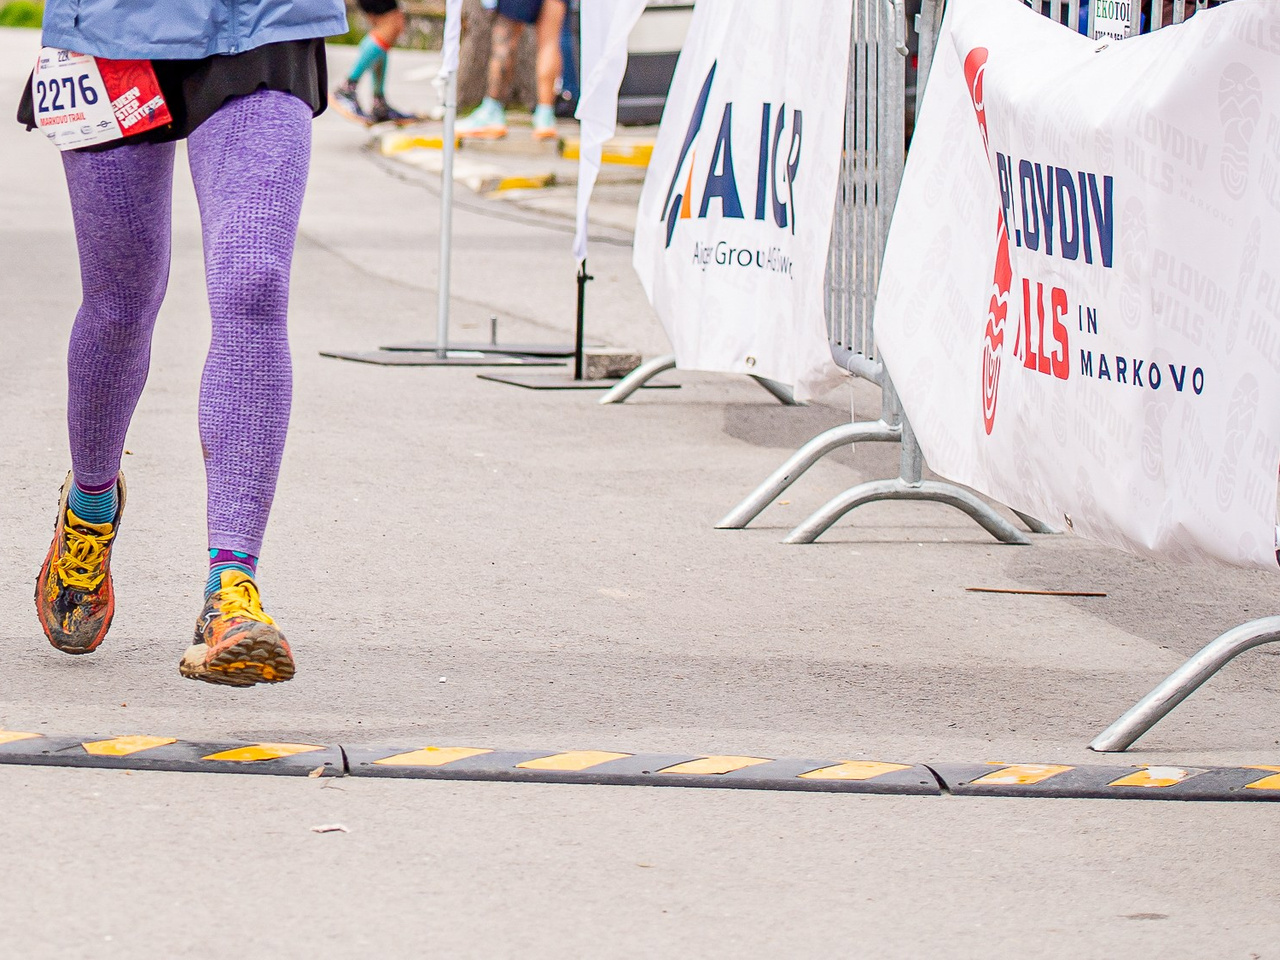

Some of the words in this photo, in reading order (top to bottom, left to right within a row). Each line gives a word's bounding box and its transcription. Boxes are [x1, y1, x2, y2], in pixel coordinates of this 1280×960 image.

[37, 73, 99, 113] 2276
[115, 100, 140, 121] STEP
[40, 115, 68, 127] MARKOVO
[68, 112, 86, 123] TRAIL
[996, 151, 1114, 269] PLOVDIV
[1078, 304, 1098, 334] IN
[1080, 348, 1204, 396] MARKOVO
